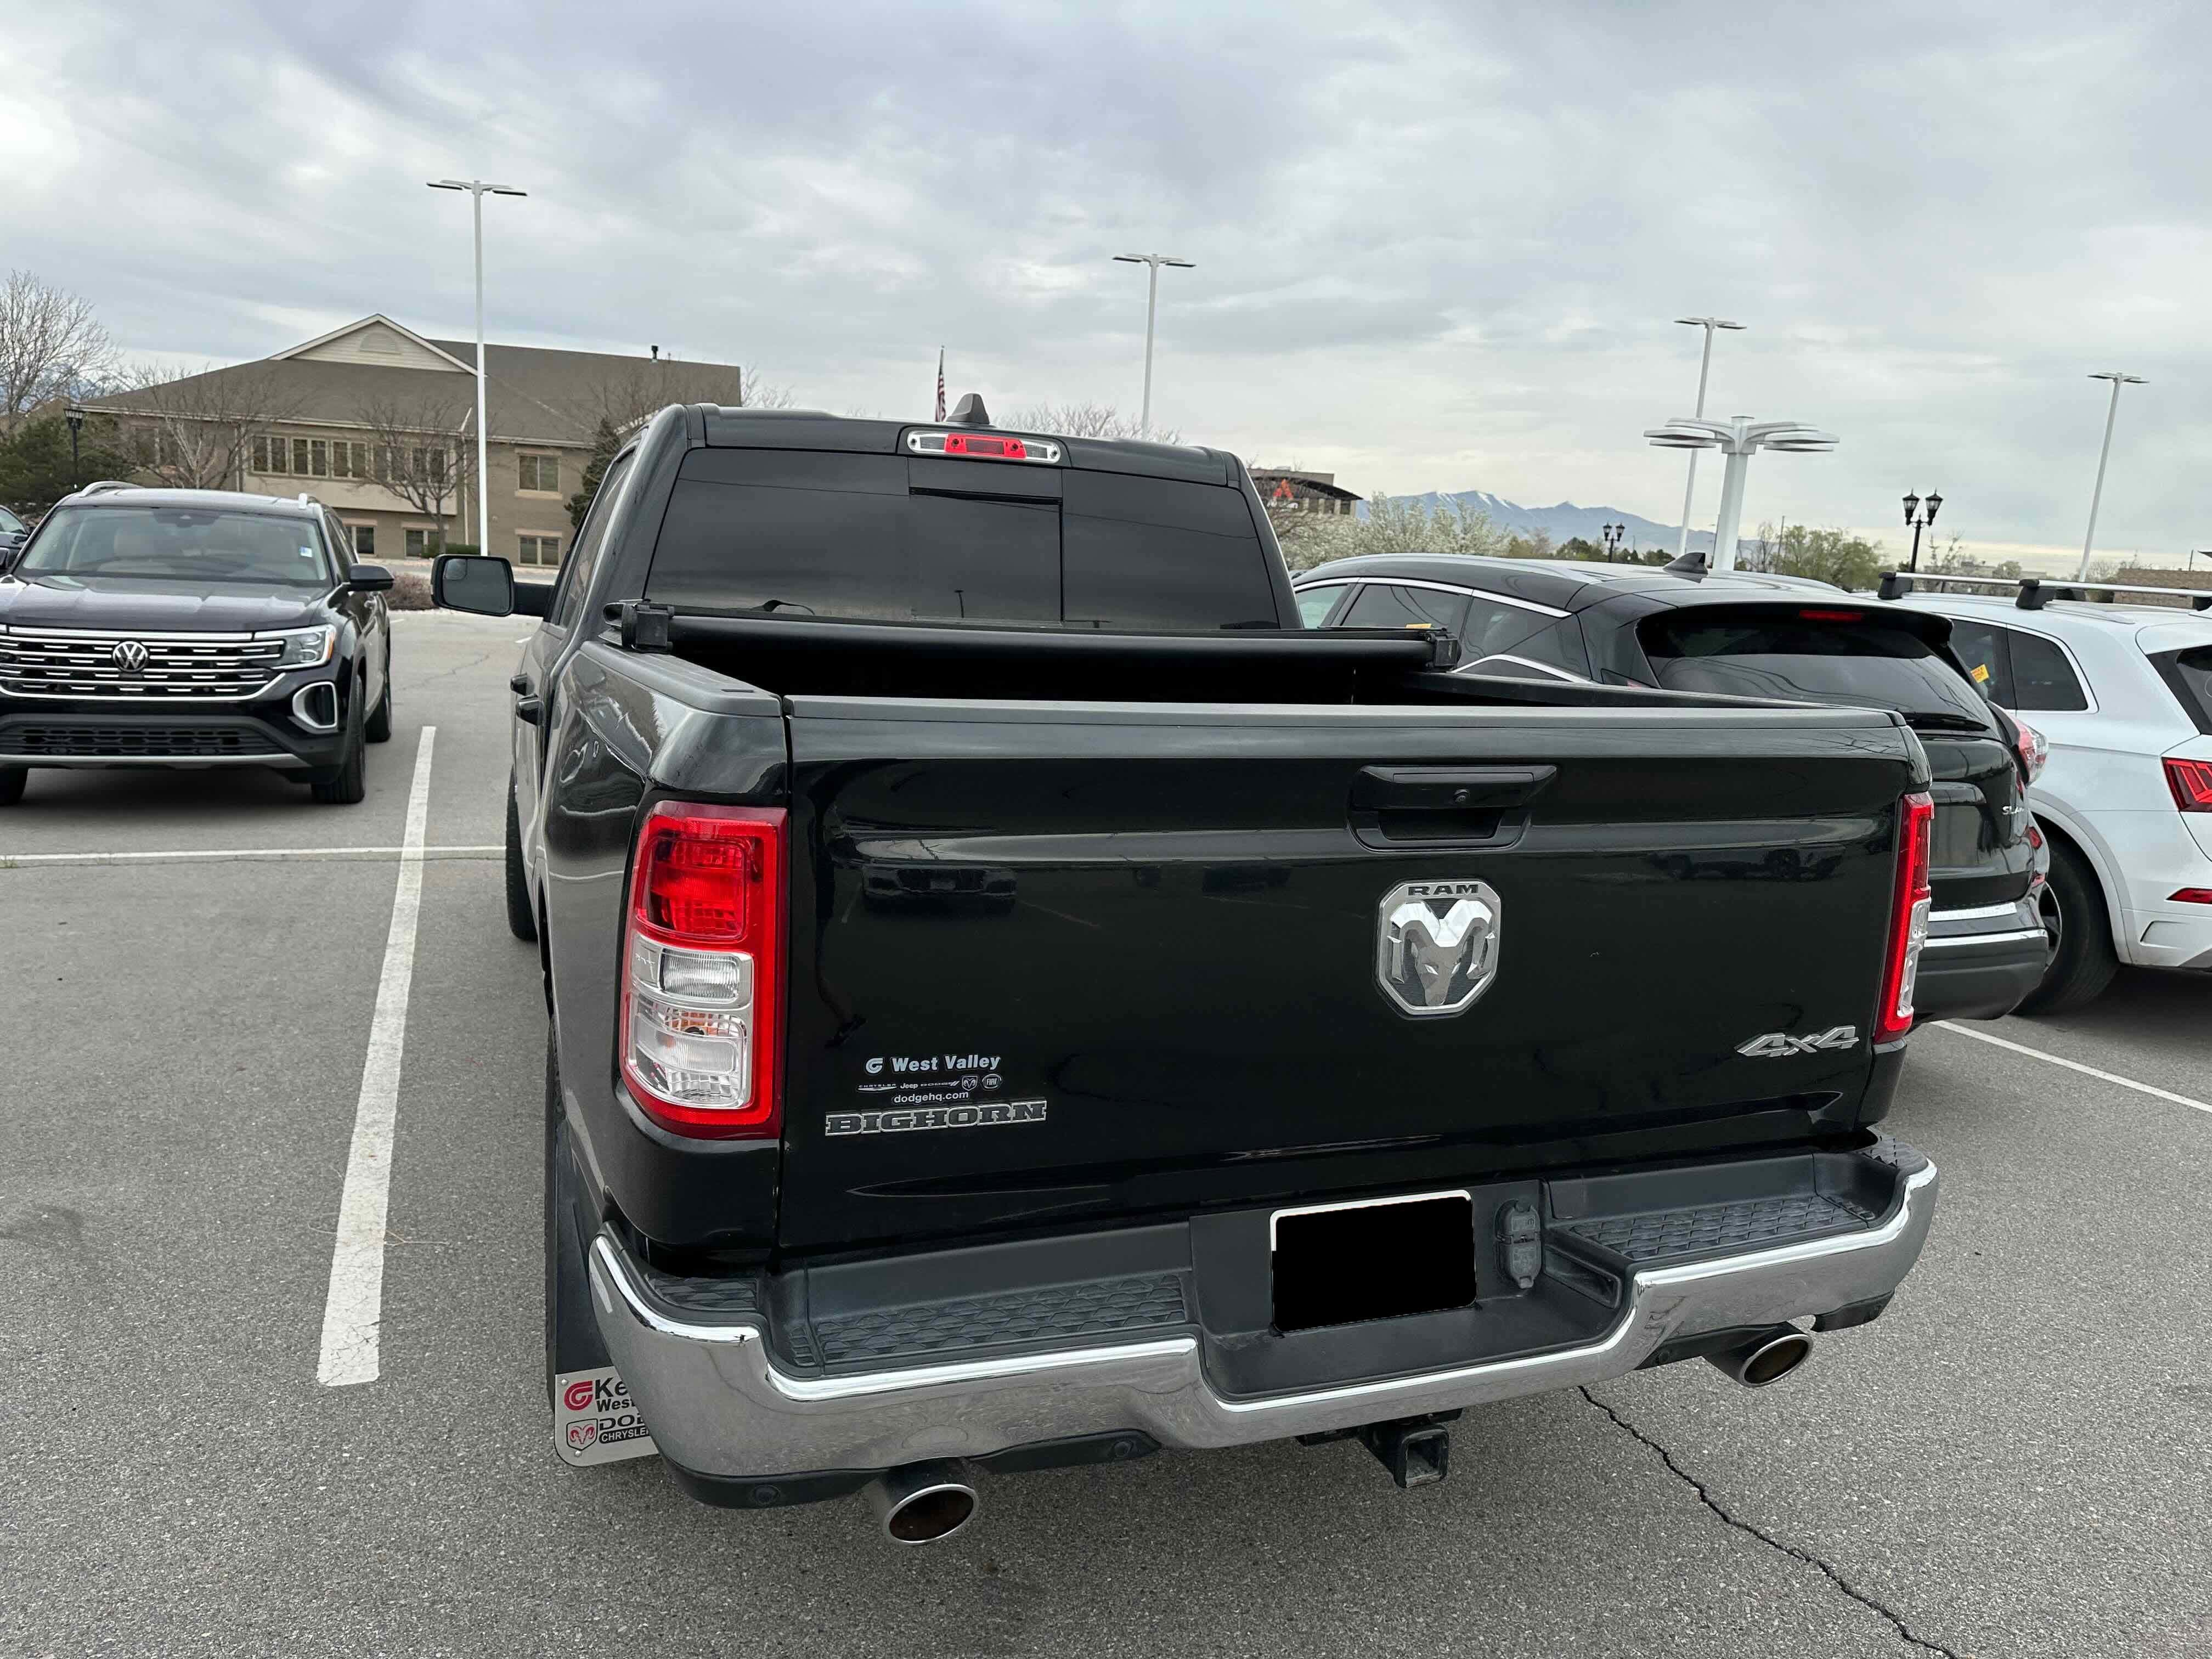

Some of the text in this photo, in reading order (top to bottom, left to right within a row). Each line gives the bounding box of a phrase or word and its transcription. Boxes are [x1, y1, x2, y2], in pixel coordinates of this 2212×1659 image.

[1408, 884, 1479, 896] RAM
[892, 1057, 938, 1073] West
[945, 1054, 1001, 1070] Valley
[894, 1091, 969, 1104] dodgehq.com
[825, 1101, 1047, 1136] BIGHORN
[601, 1427, 648, 1442] CHRYSLE
